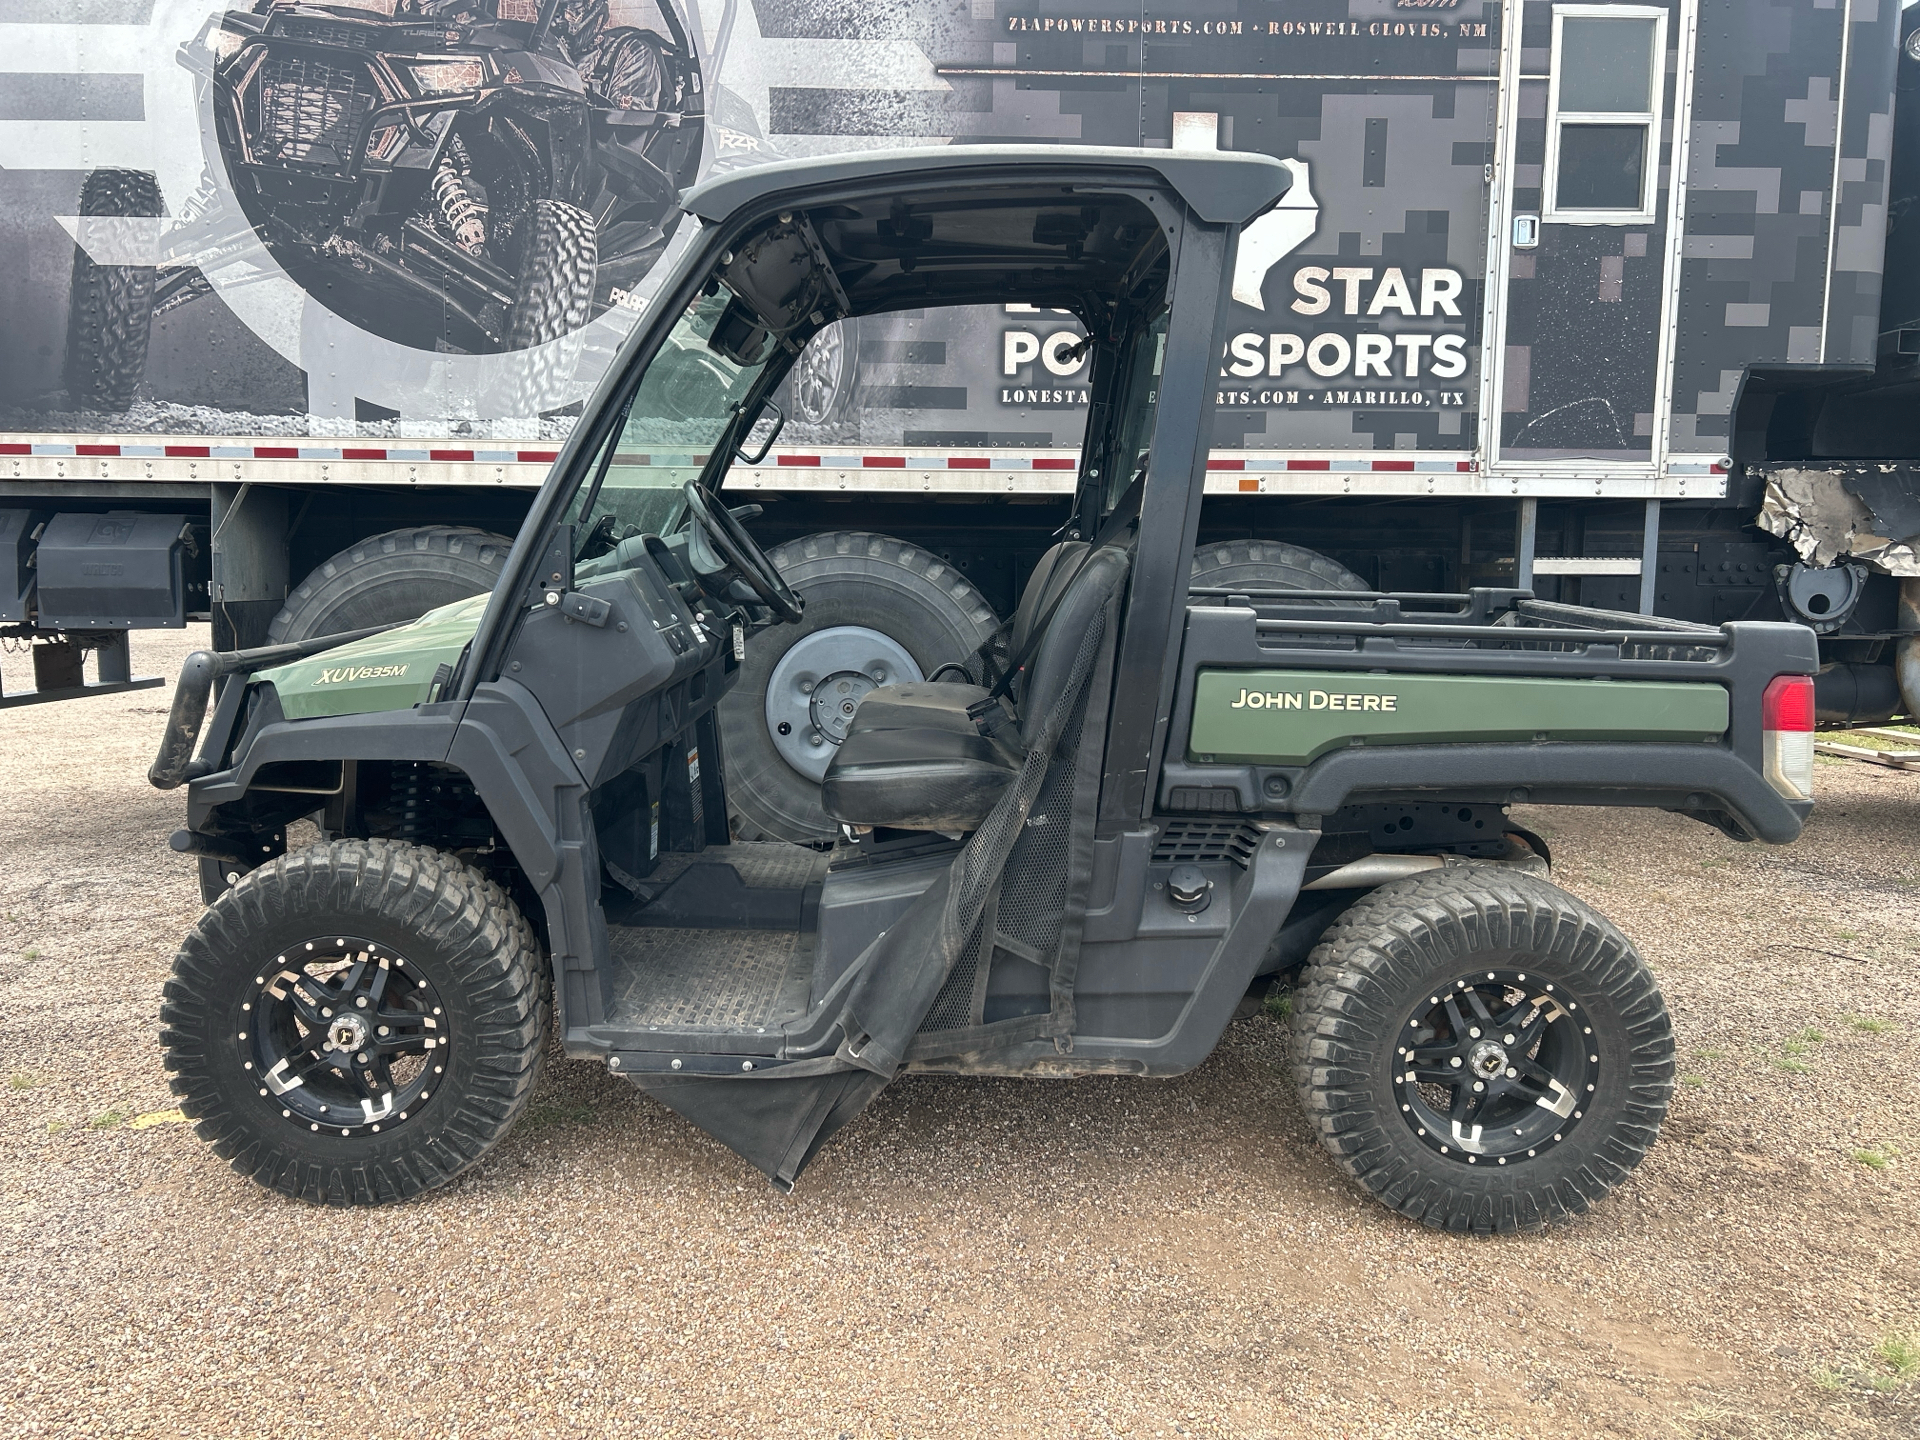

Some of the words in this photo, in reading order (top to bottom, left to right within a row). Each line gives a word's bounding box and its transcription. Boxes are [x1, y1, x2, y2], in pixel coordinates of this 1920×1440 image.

[1008, 17, 1244, 35] ZIAPOWERSPORTS.COM
[1459, 23, 1488, 38] NM
[719, 133, 762, 152] RZR
[608, 286, 651, 313] POLAR
[1290, 266, 1464, 317] STAR
[1323, 391, 1431, 407] AMARILLO,
[1440, 392, 1465, 406] TX
[313, 664, 409, 685] XUV835M
[1231, 688, 1304, 711] JOHN
[1308, 689, 1399, 713] DEERE
